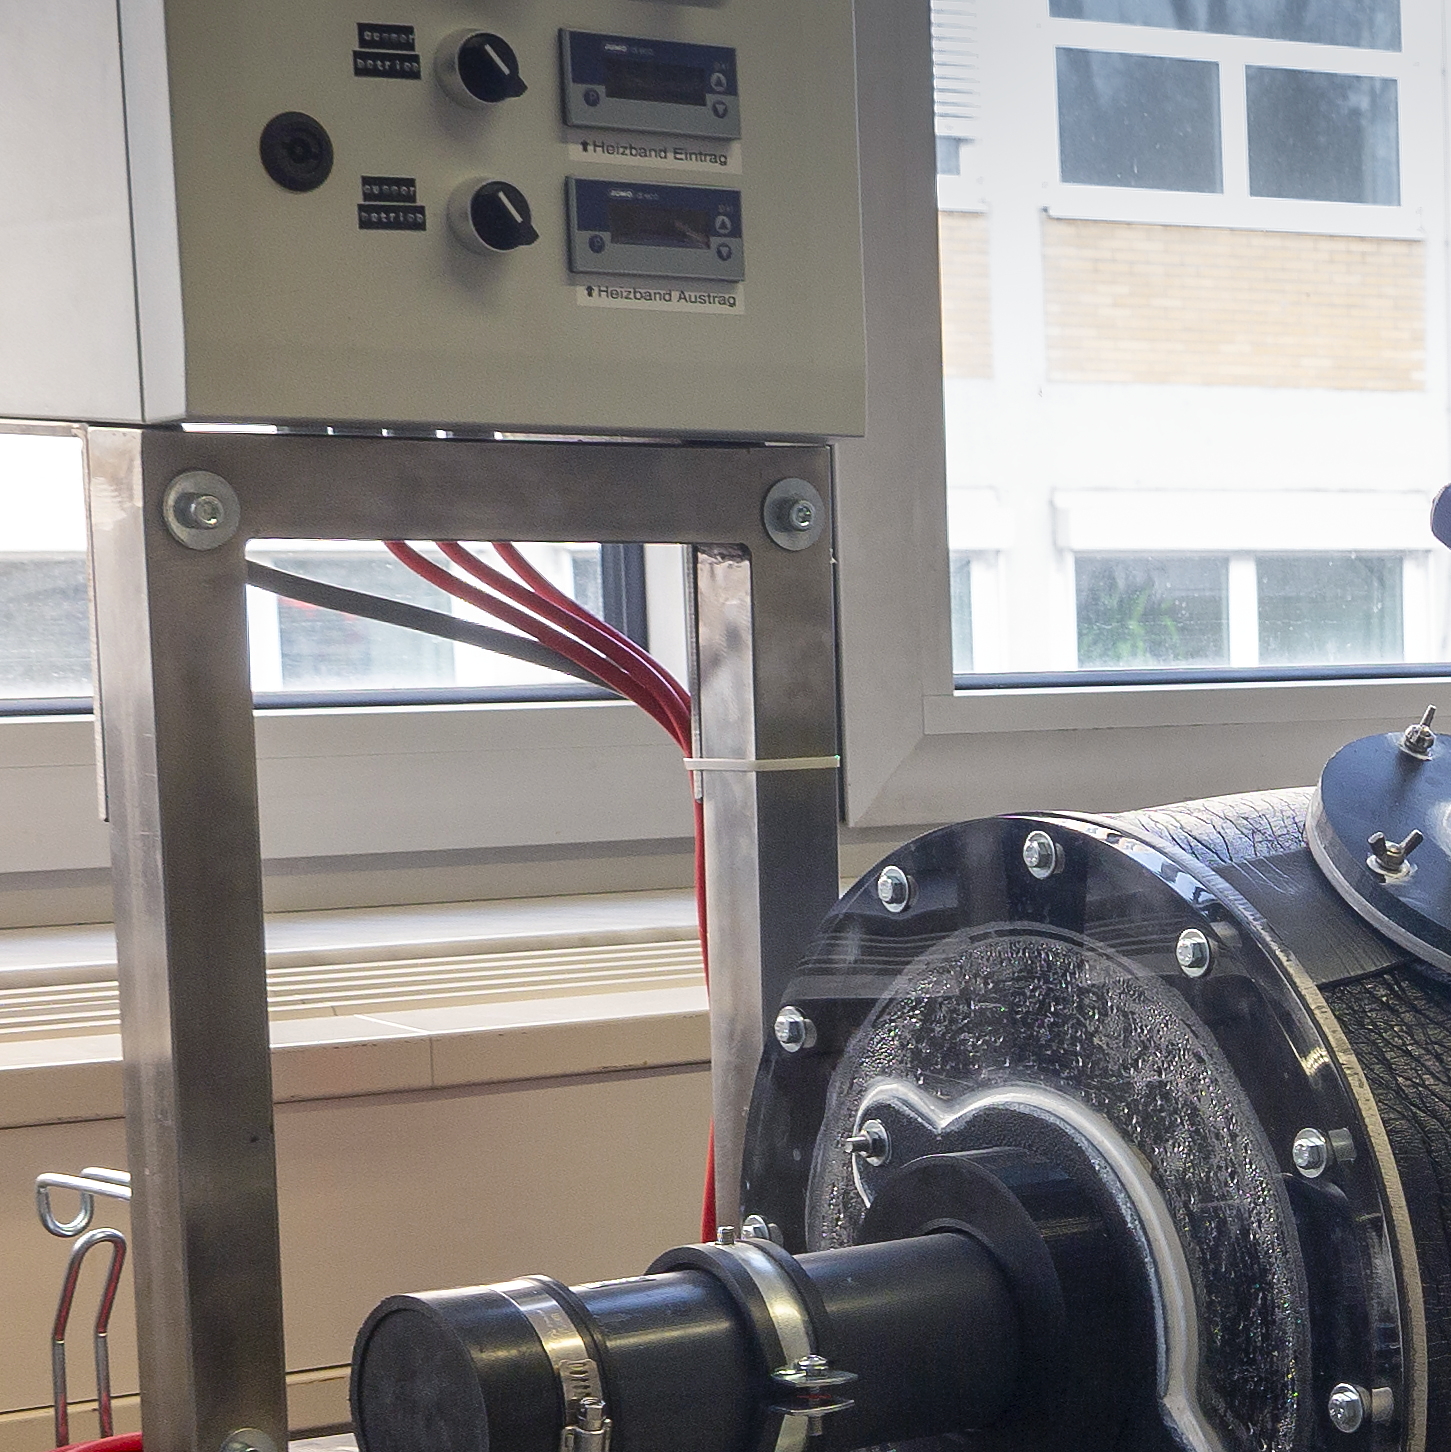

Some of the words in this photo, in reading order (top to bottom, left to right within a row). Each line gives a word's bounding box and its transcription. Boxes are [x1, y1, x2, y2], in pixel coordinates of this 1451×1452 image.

[593, 140, 667, 160] Heizband
[673, 147, 728, 166] Eintrag
[598, 285, 672, 302] Heizband
[677, 290, 736, 307] Austrag
